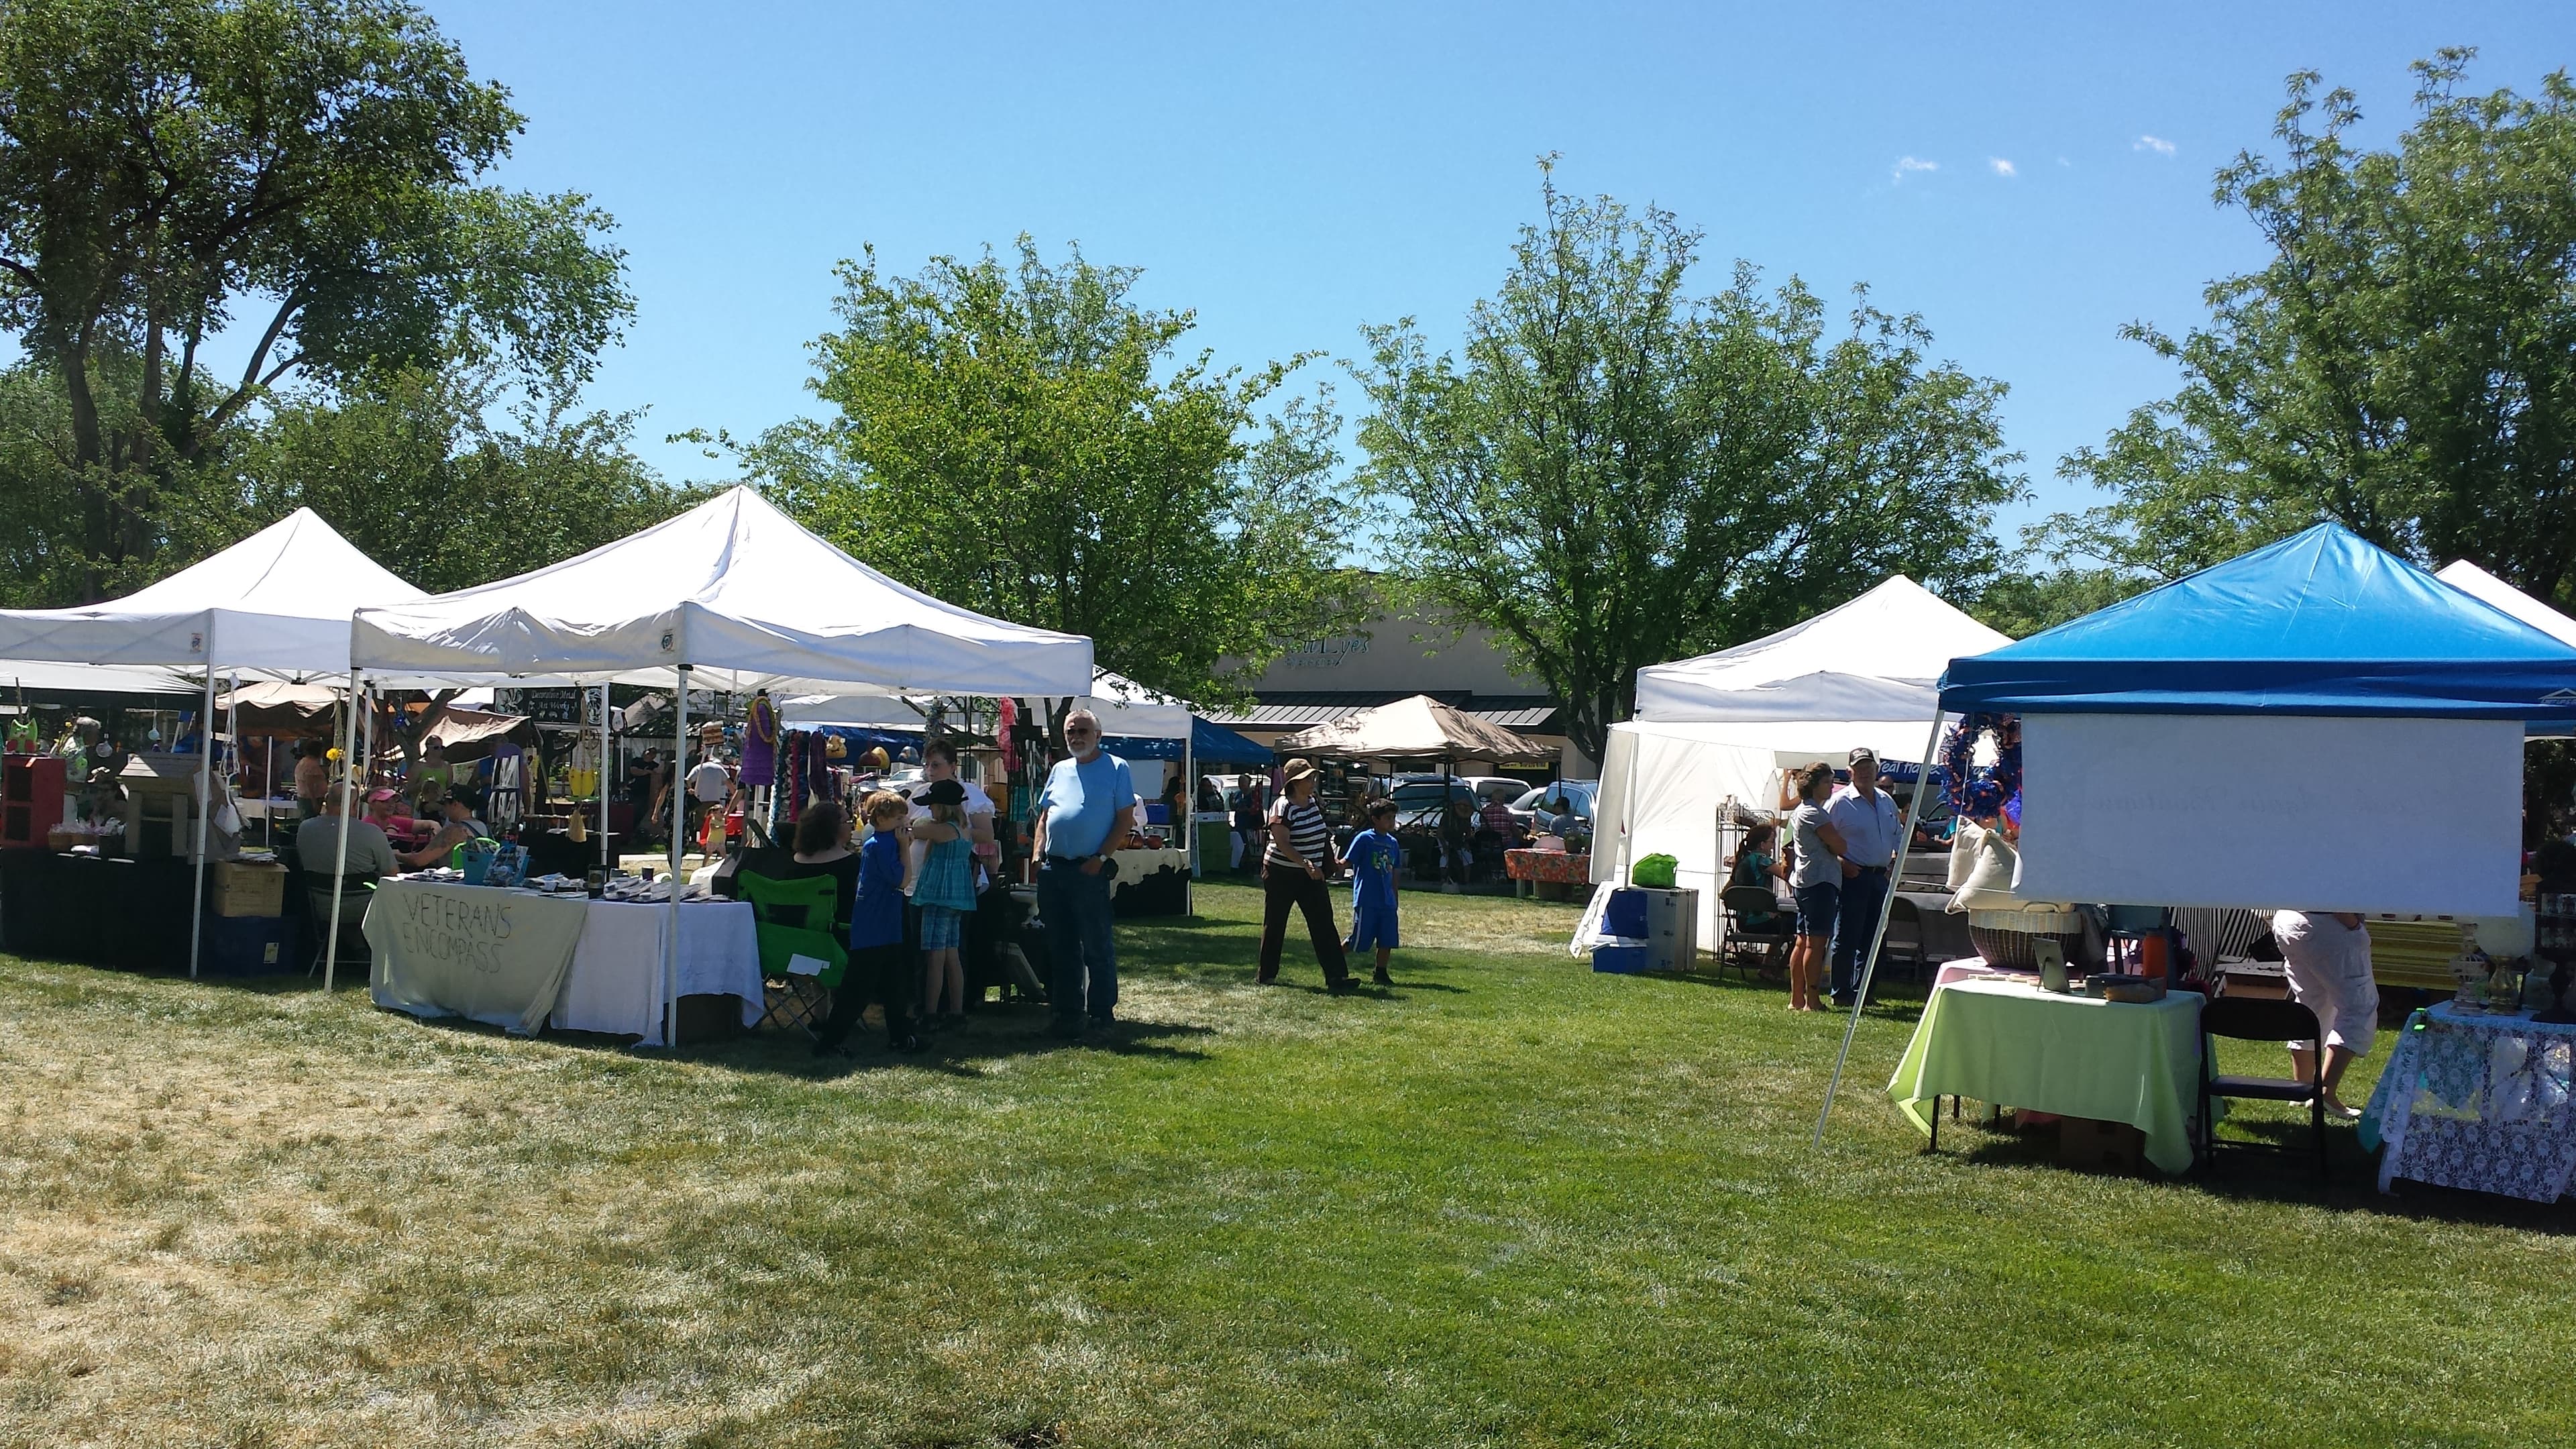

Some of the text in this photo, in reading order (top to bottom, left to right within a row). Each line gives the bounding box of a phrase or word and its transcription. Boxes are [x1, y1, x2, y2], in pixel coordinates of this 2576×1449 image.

[560, 690, 576, 698] Metal
[402, 893, 511, 938] VETERANS
[402, 922, 504, 973] ENCOMPASS
